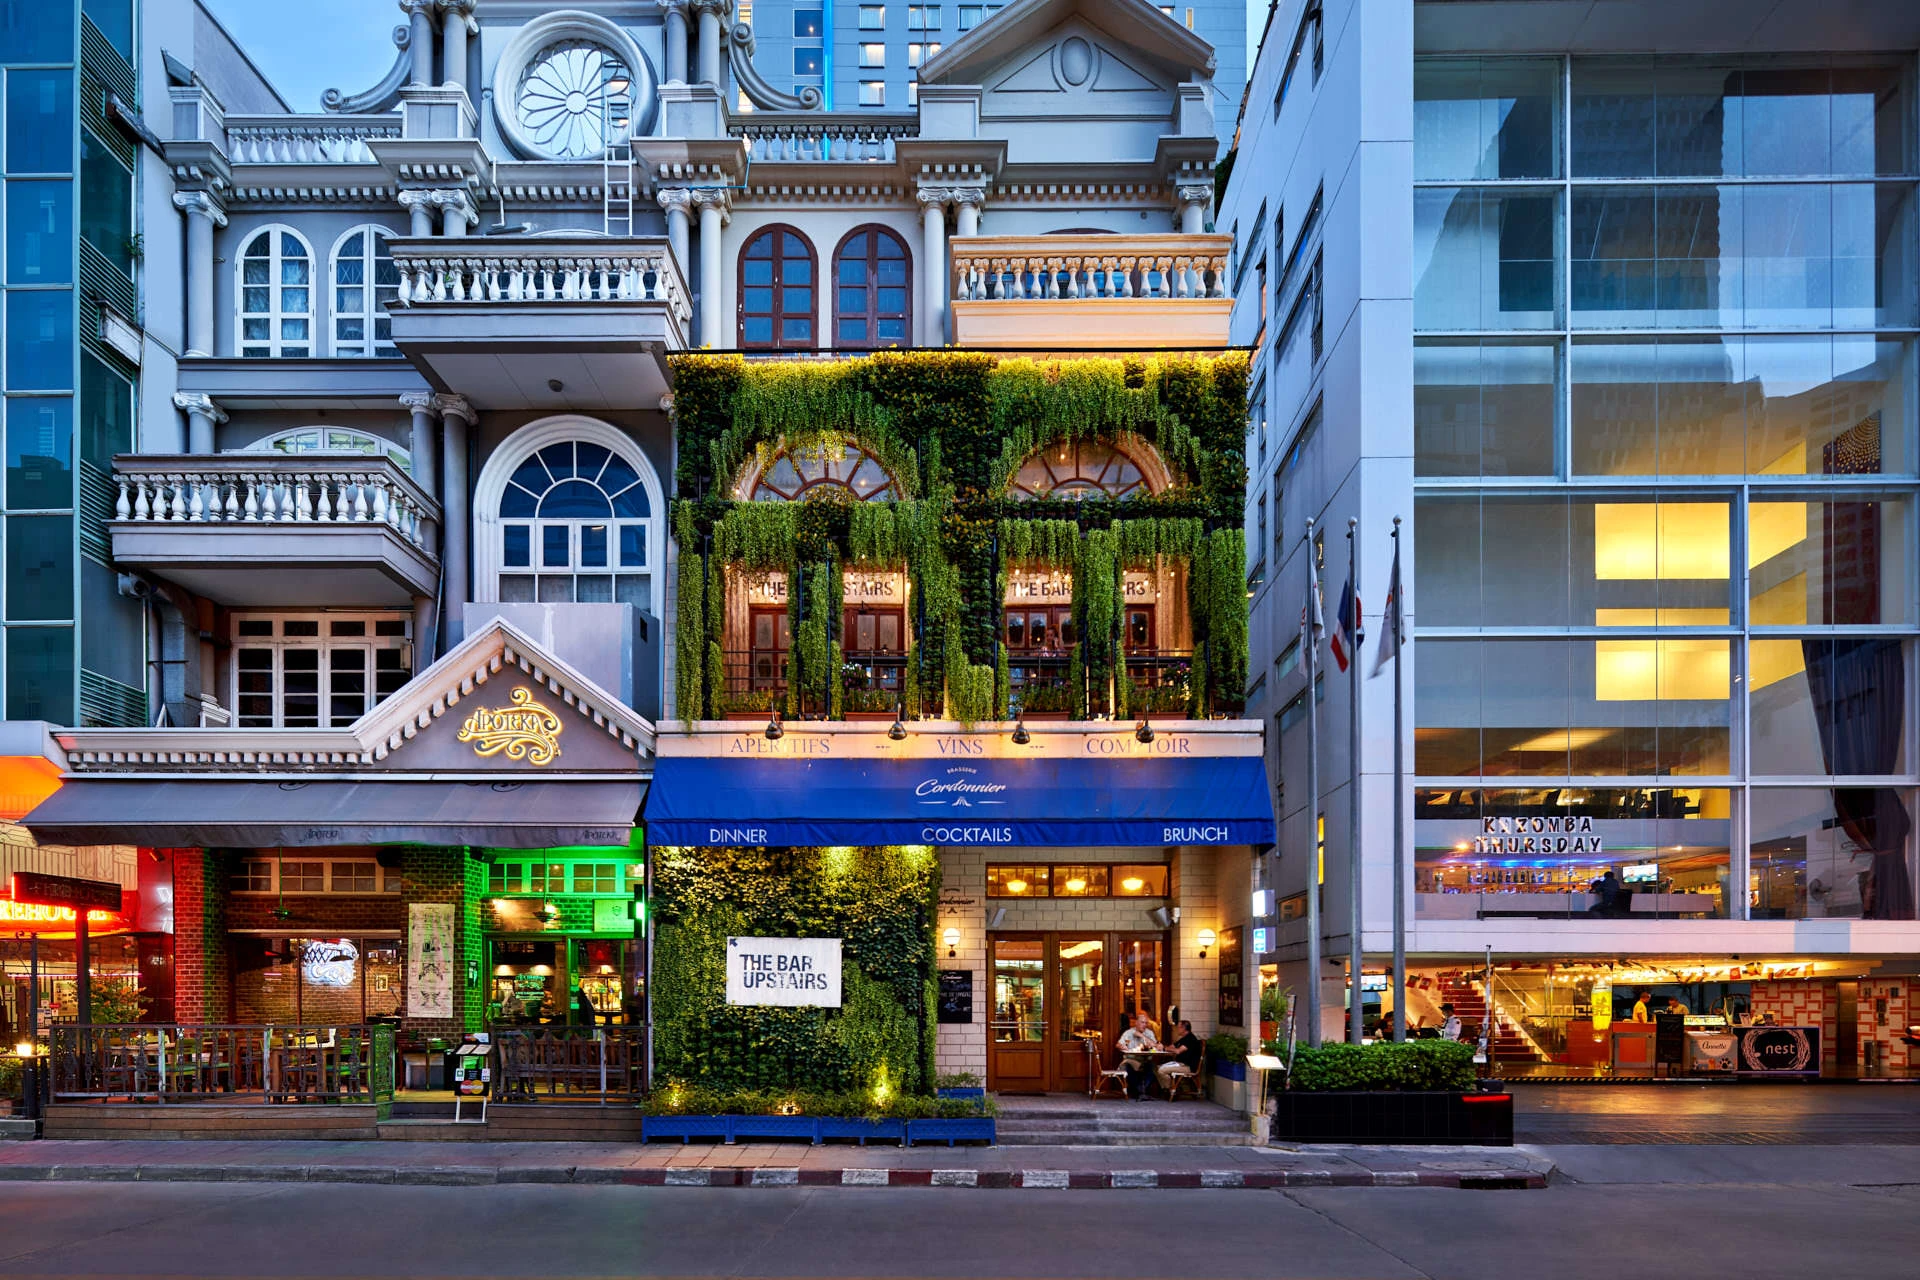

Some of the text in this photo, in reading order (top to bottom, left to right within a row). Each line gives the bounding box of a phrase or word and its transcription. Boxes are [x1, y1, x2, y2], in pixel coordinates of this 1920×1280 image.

[760, 581, 786, 596] THE
[1011, 581, 1038, 597] THE
[457, 708, 546, 738] APOTEKA
[937, 737, 983, 754] VINS
[915, 778, 1006, 796] Cordonnier
[710, 826, 1228, 843] DINNER COCKTAILS BRUNCH
[1476, 836, 1601, 853] THURSDAY
[739, 953, 813, 972] THE BAR
[743, 971, 828, 990] UPSTAIRS
[1765, 1043, 1796, 1055] nest
